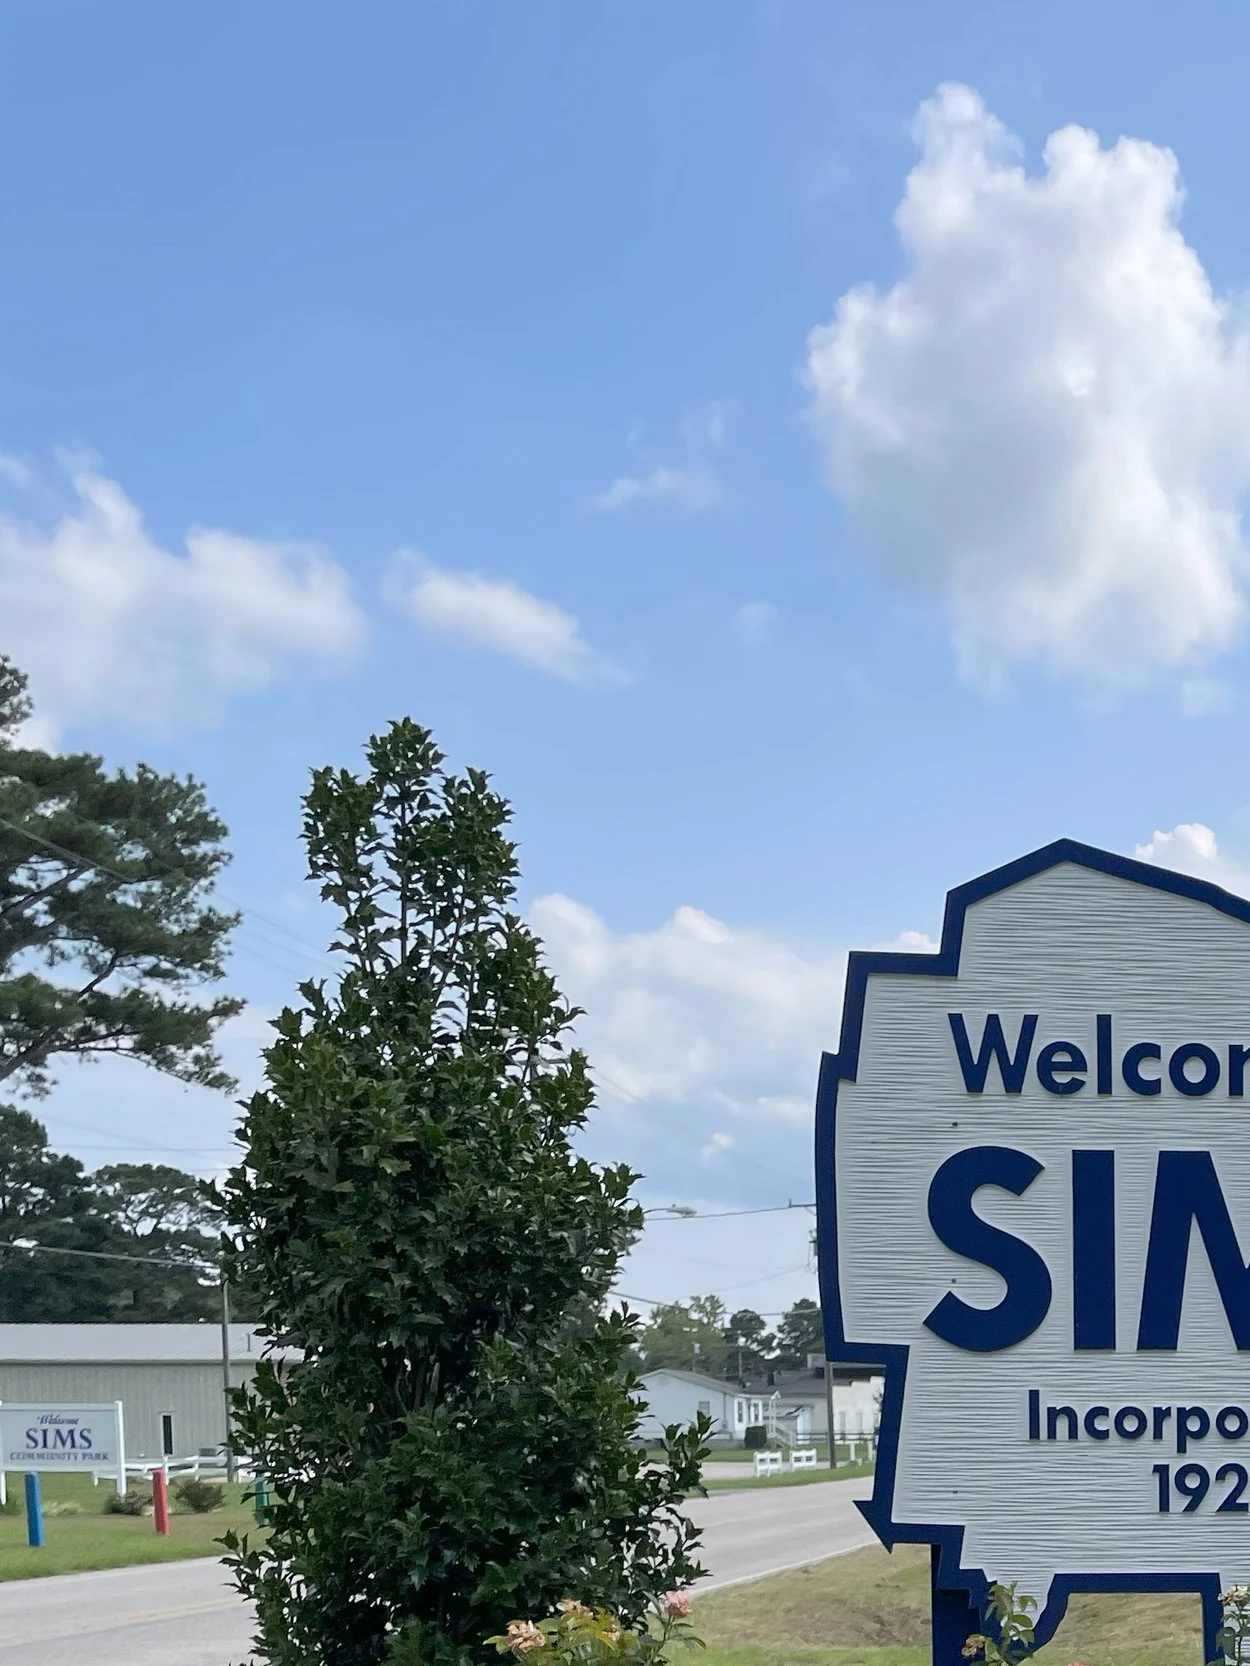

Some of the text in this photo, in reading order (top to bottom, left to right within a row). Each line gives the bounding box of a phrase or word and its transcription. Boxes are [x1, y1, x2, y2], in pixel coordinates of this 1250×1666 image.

[25, 1427, 92, 1450] SIMS
[10, 1451, 109, 1461] COMMUNITY PARK
